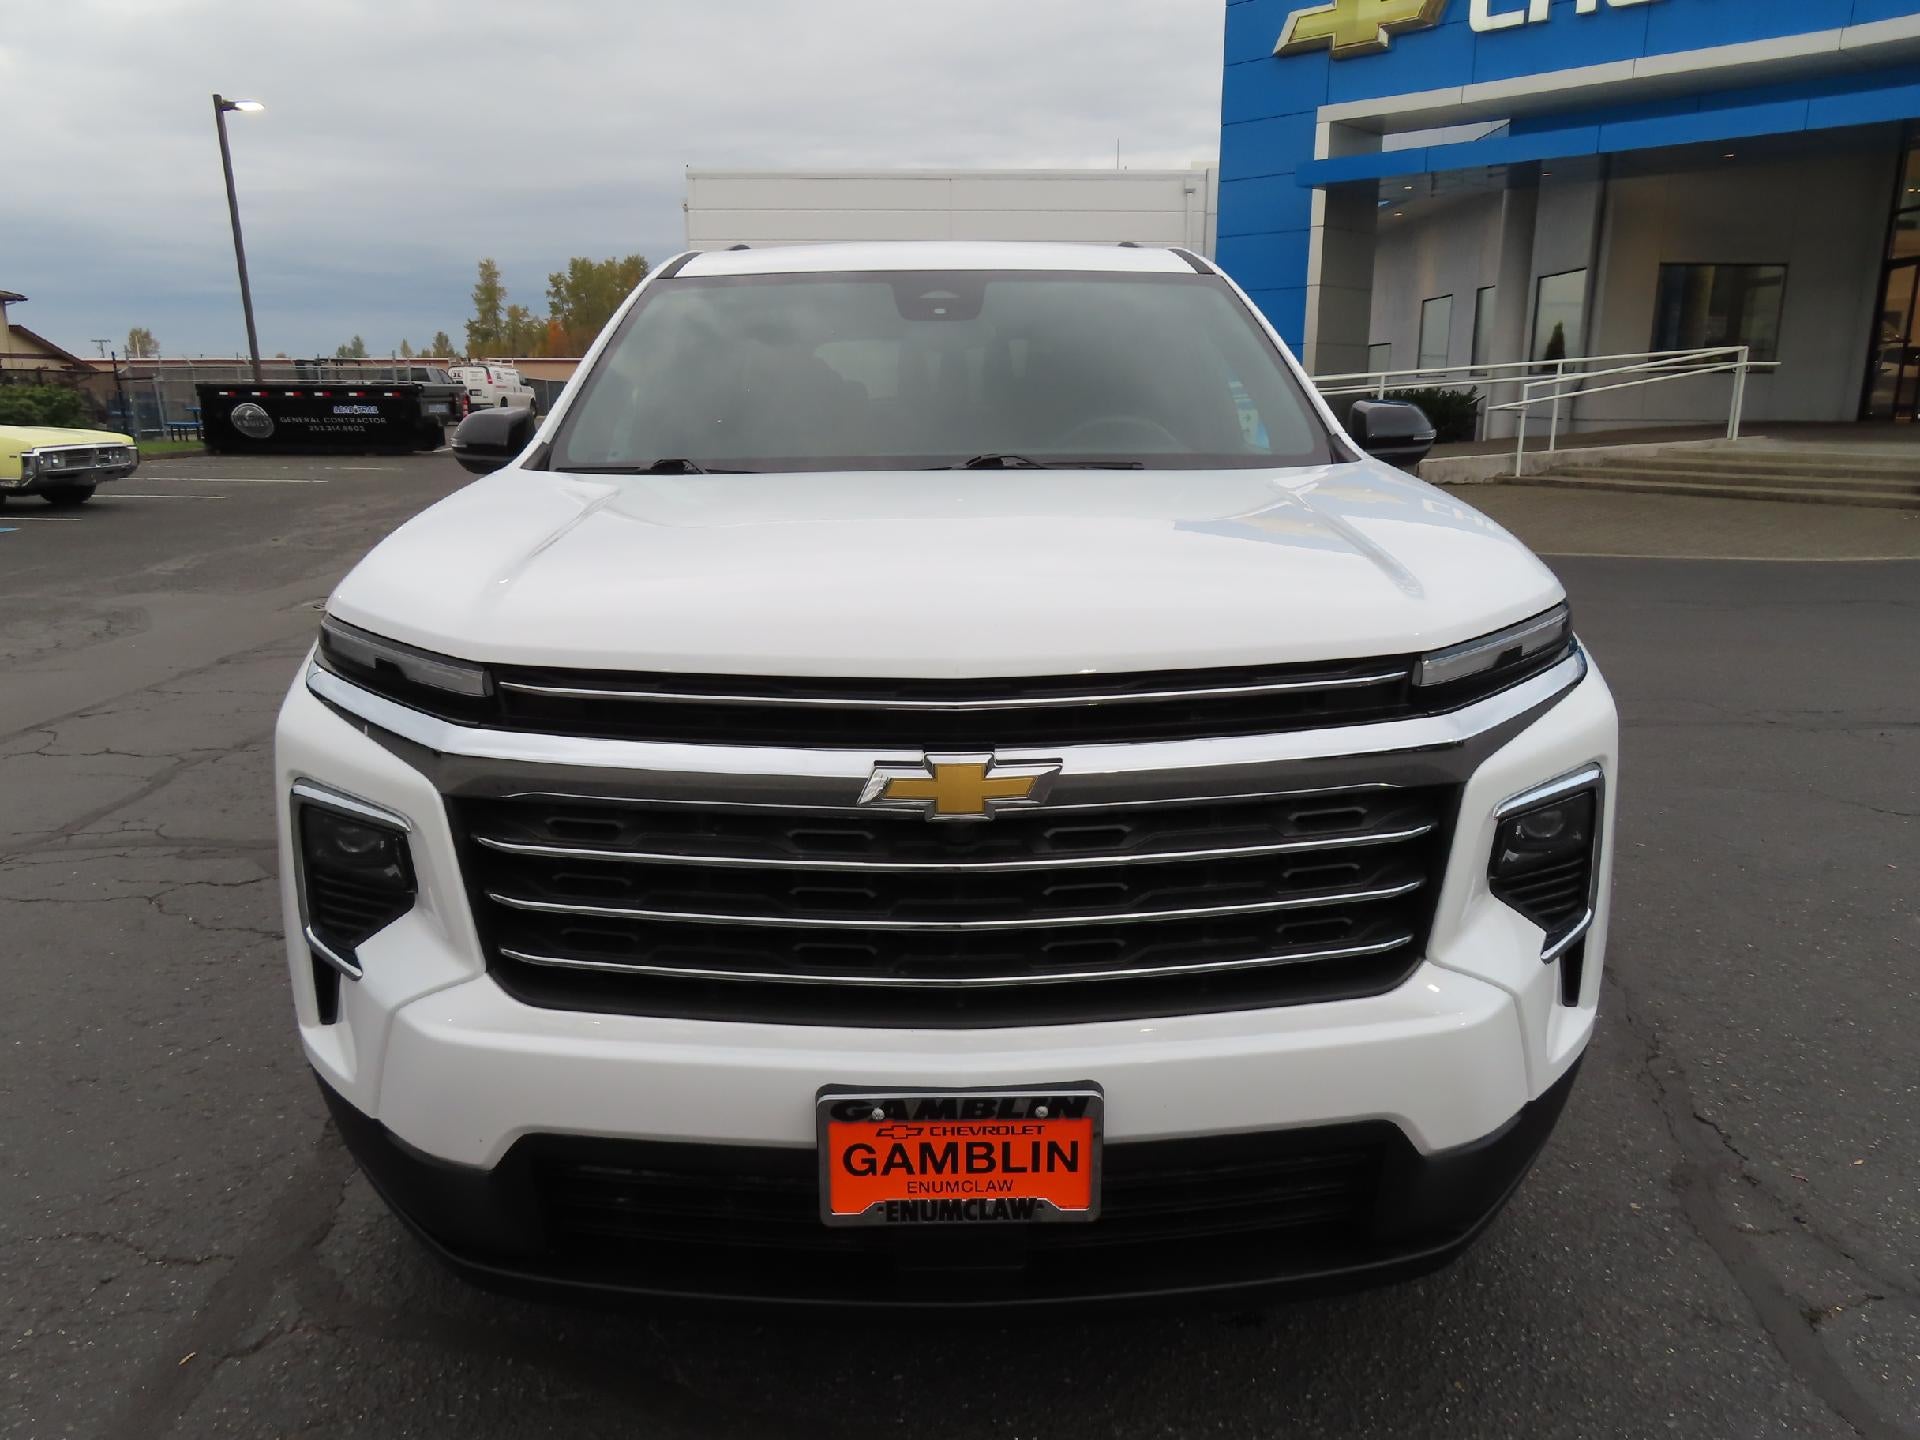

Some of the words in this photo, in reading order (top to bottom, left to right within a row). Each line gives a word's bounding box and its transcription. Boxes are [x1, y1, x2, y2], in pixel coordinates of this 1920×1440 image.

[279, 416, 321, 424] GENERAL
[323, 416, 387, 424] CONTRACTOR
[830, 1098, 1088, 1121] GAMBLIN
[929, 1125, 1045, 1137] CHEVROLET
[842, 1141, 1079, 1177] GAMBLIN
[906, 1179, 1014, 1194] ENUMCLAW
[885, 1198, 1037, 1222] ENUMCLAW
